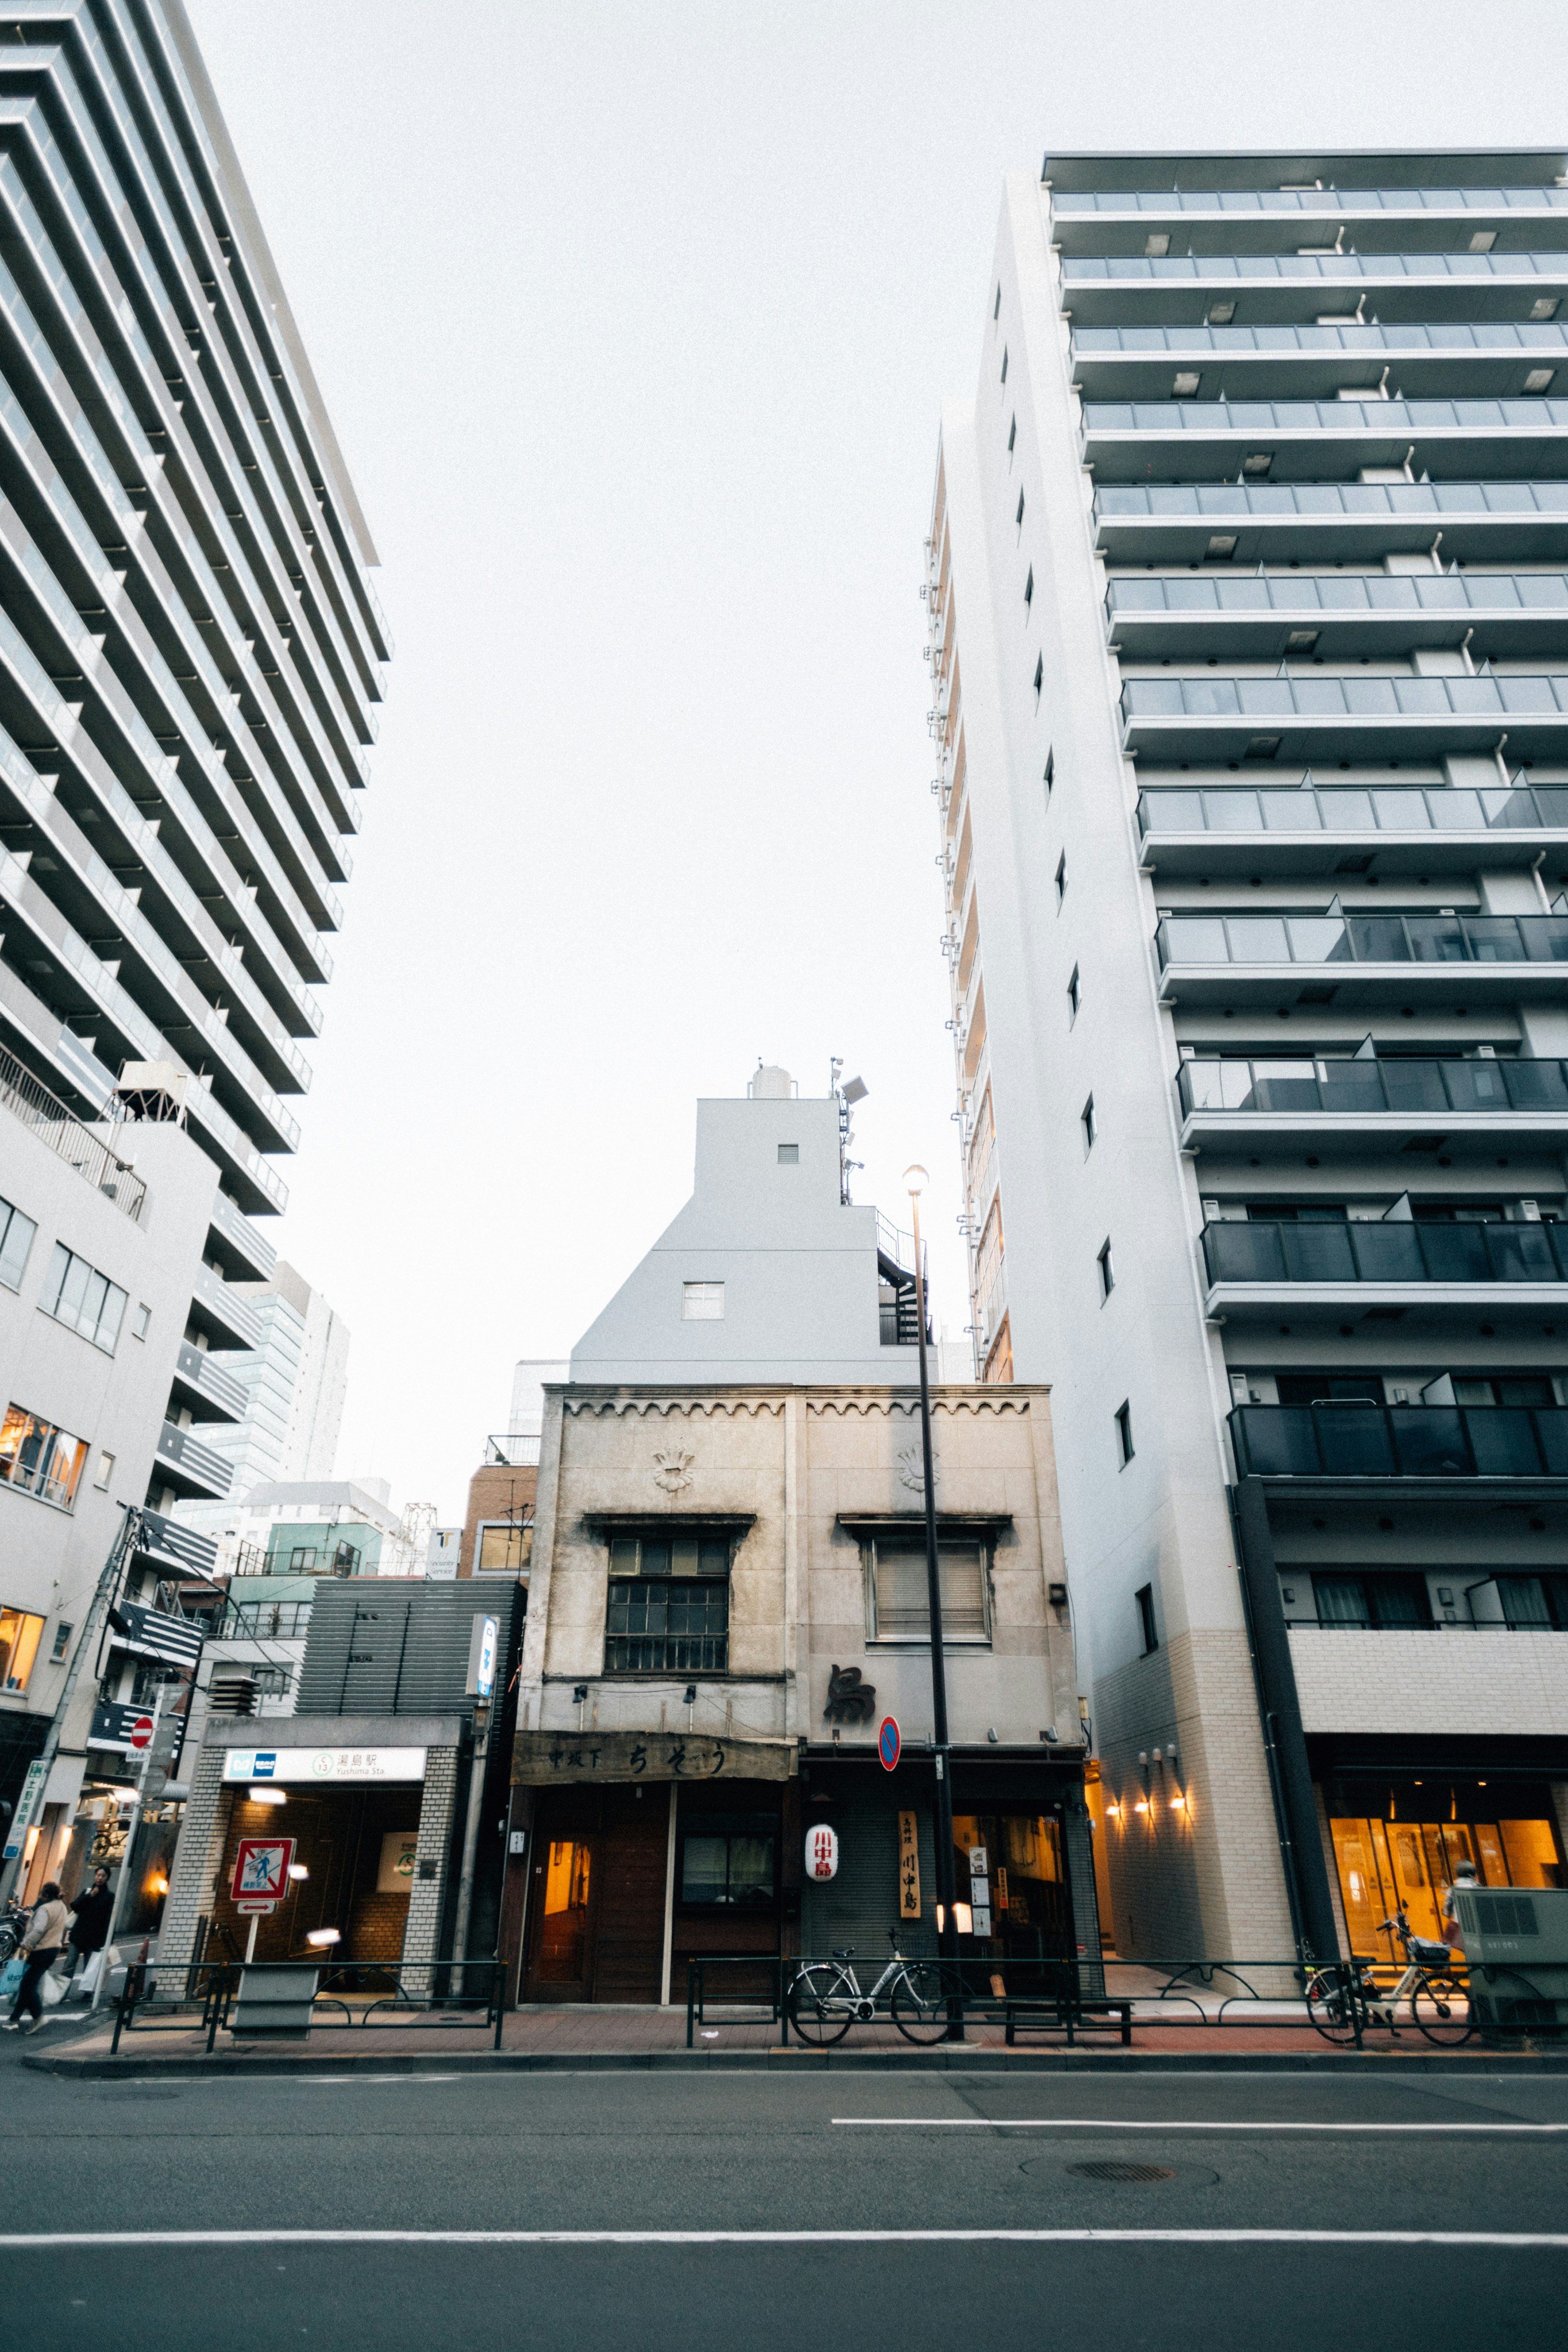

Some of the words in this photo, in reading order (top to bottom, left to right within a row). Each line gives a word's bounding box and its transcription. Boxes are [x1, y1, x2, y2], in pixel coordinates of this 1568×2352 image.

[337, 1754, 376, 1766] 湯島駅
[549, 1748, 602, 1769] 中坂下
[17, 1780, 36, 1824] 上野医院
[814, 1832, 832, 1877] 川中島
[903, 1854, 917, 1910] 川中島
